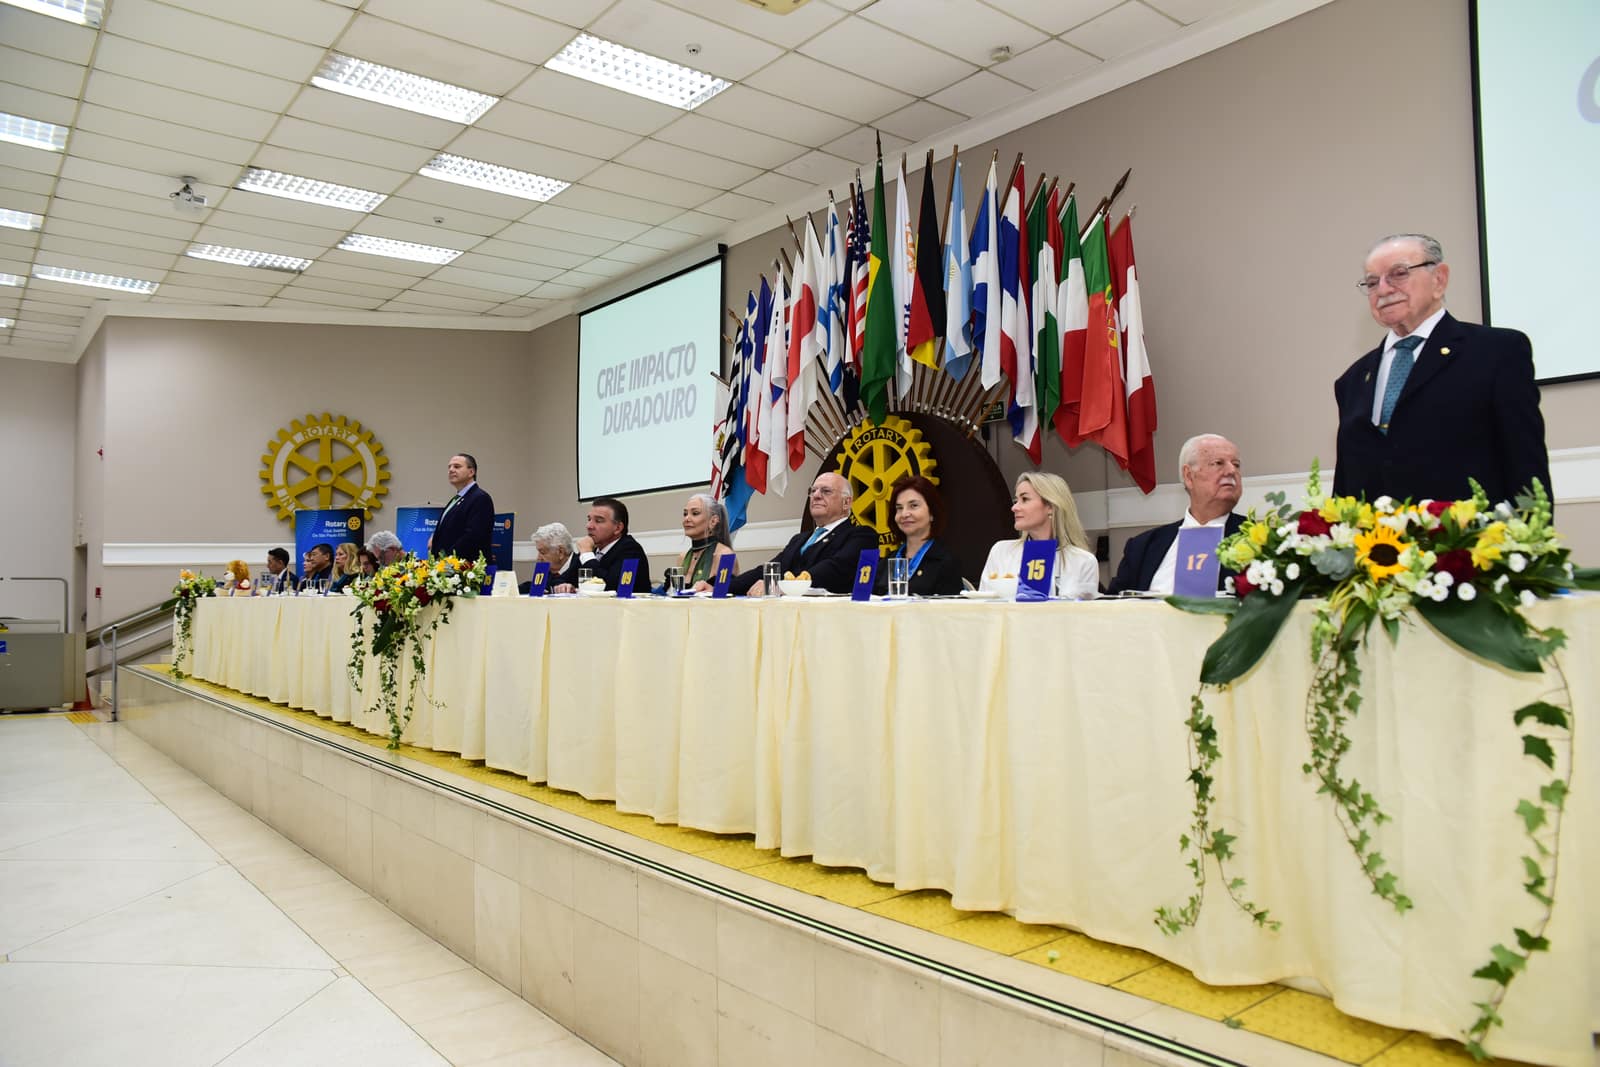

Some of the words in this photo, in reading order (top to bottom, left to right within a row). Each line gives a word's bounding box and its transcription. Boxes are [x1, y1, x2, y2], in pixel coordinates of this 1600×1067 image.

[597, 362, 627, 400] CRIE
[629, 341, 697, 392] IMPACTO
[602, 384, 697, 436] DURADOURO
[854, 428, 902, 450] ROTARY
[325, 520, 346, 529] Rotary
[425, 518, 439, 526] Rota
[1027, 559, 1046, 581] 15
[1187, 553, 1209, 571] 17
[534, 572, 545, 585] 07
[719, 567, 728, 584] 11
[859, 566, 872, 584] 13
